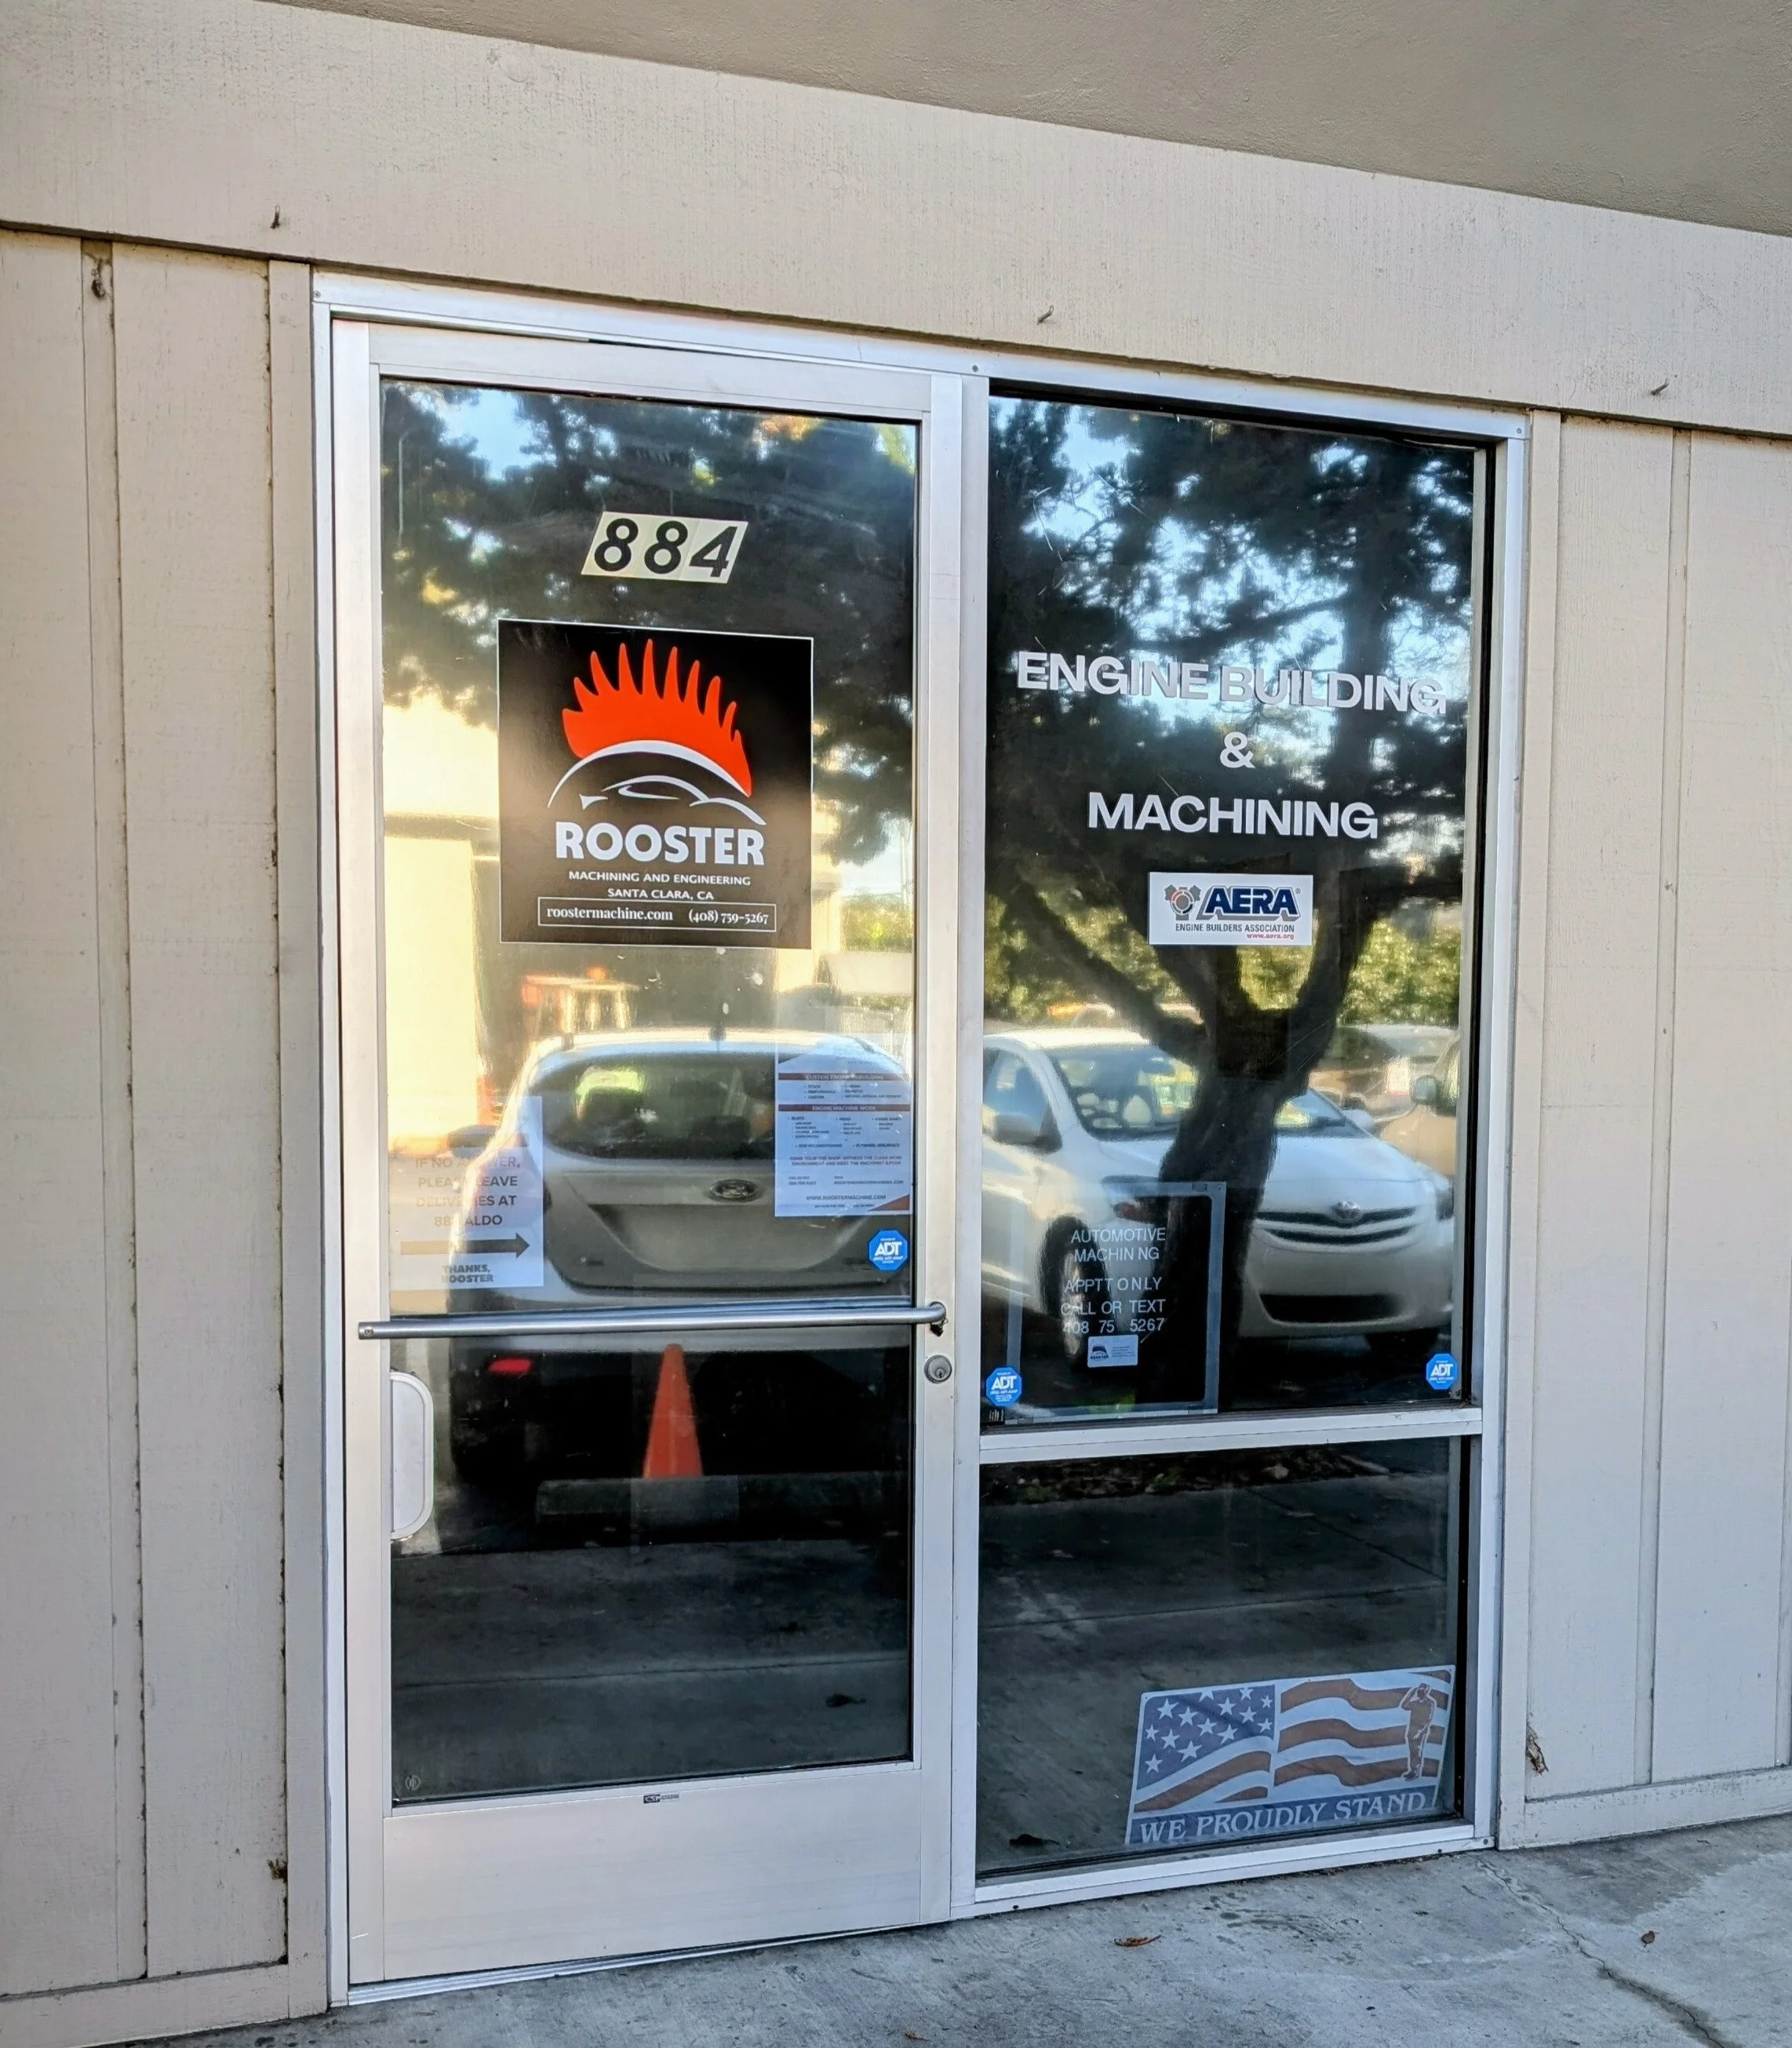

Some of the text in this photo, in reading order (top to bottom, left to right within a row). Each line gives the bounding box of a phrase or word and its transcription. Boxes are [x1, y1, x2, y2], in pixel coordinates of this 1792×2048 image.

[594, 518, 739, 578] 884
[1018, 651, 1446, 714] ENGINE BUILDING
[1220, 731, 1255, 768] &
[1088, 791, 1378, 839] MACHINING
[555, 822, 765, 865] ROOSTER
[569, 871, 751, 885] MACHINING AND ENGINEERING
[607, 888, 714, 901] SANTA CLARA, CA
[1202, 887, 1299, 916] AERA
[547, 906, 769, 925] roostermachine.com (408) 759-5267
[430, 1157, 453, 1168] NO
[417, 1195, 516, 1208] DELIVEIES AT
[1071, 1227, 1166, 1244] AUTOMOTIVE
[875, 1241, 901, 1255] ADT
[1117, 1277, 1162, 1291] ONLY
[1061, 1299, 1166, 1315] CALL OR TEXT
[1099, 1320, 1114, 1333] 75
[1130, 1317, 1164, 1332] 5267
[1430, 1364, 1453, 1376] ADT
[991, 1376, 1017, 1390] ADT
[1139, 1791, 1426, 1843] WE PROUDLY STAND
